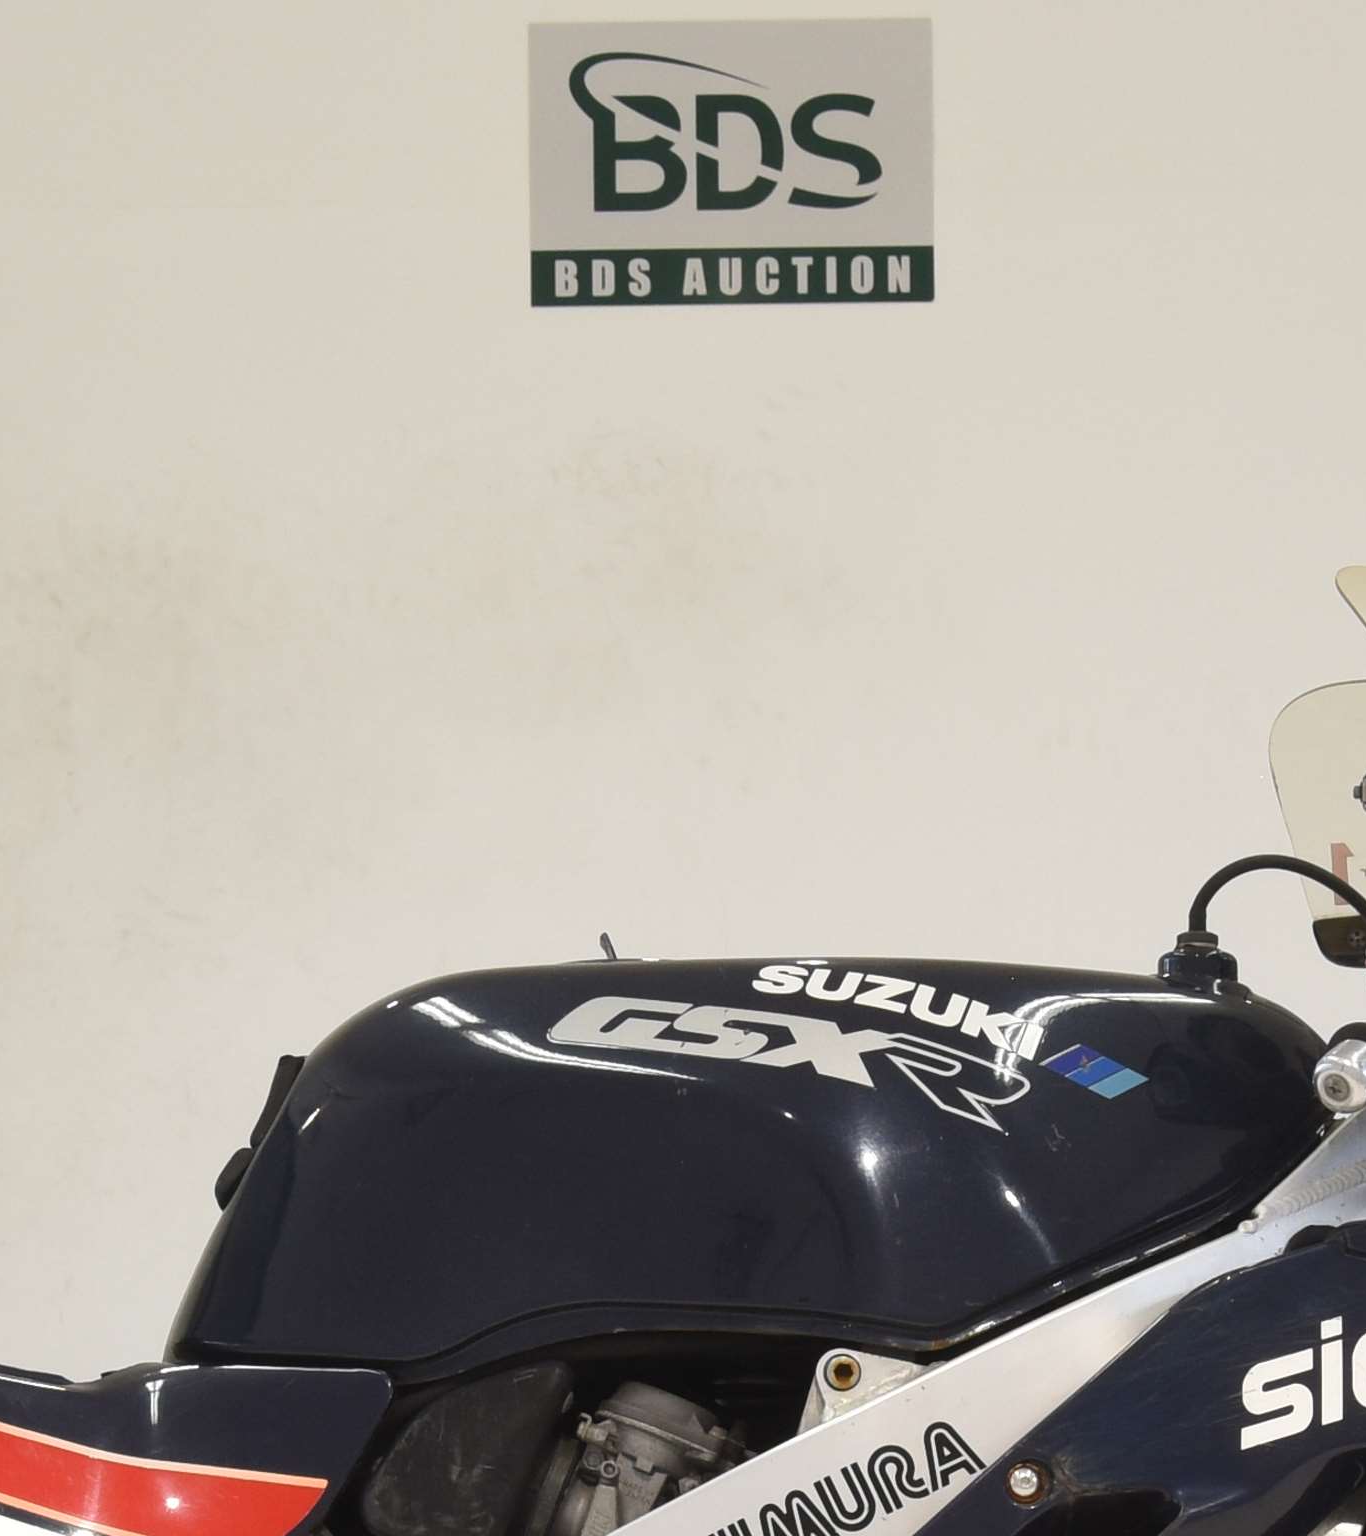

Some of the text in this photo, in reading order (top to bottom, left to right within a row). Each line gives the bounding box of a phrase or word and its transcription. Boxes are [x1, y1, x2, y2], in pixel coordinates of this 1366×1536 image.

[569, 53, 883, 212] BDS
[554, 255, 911, 298] BDS AUCTION
[752, 965, 1045, 1061] SUZUKI
